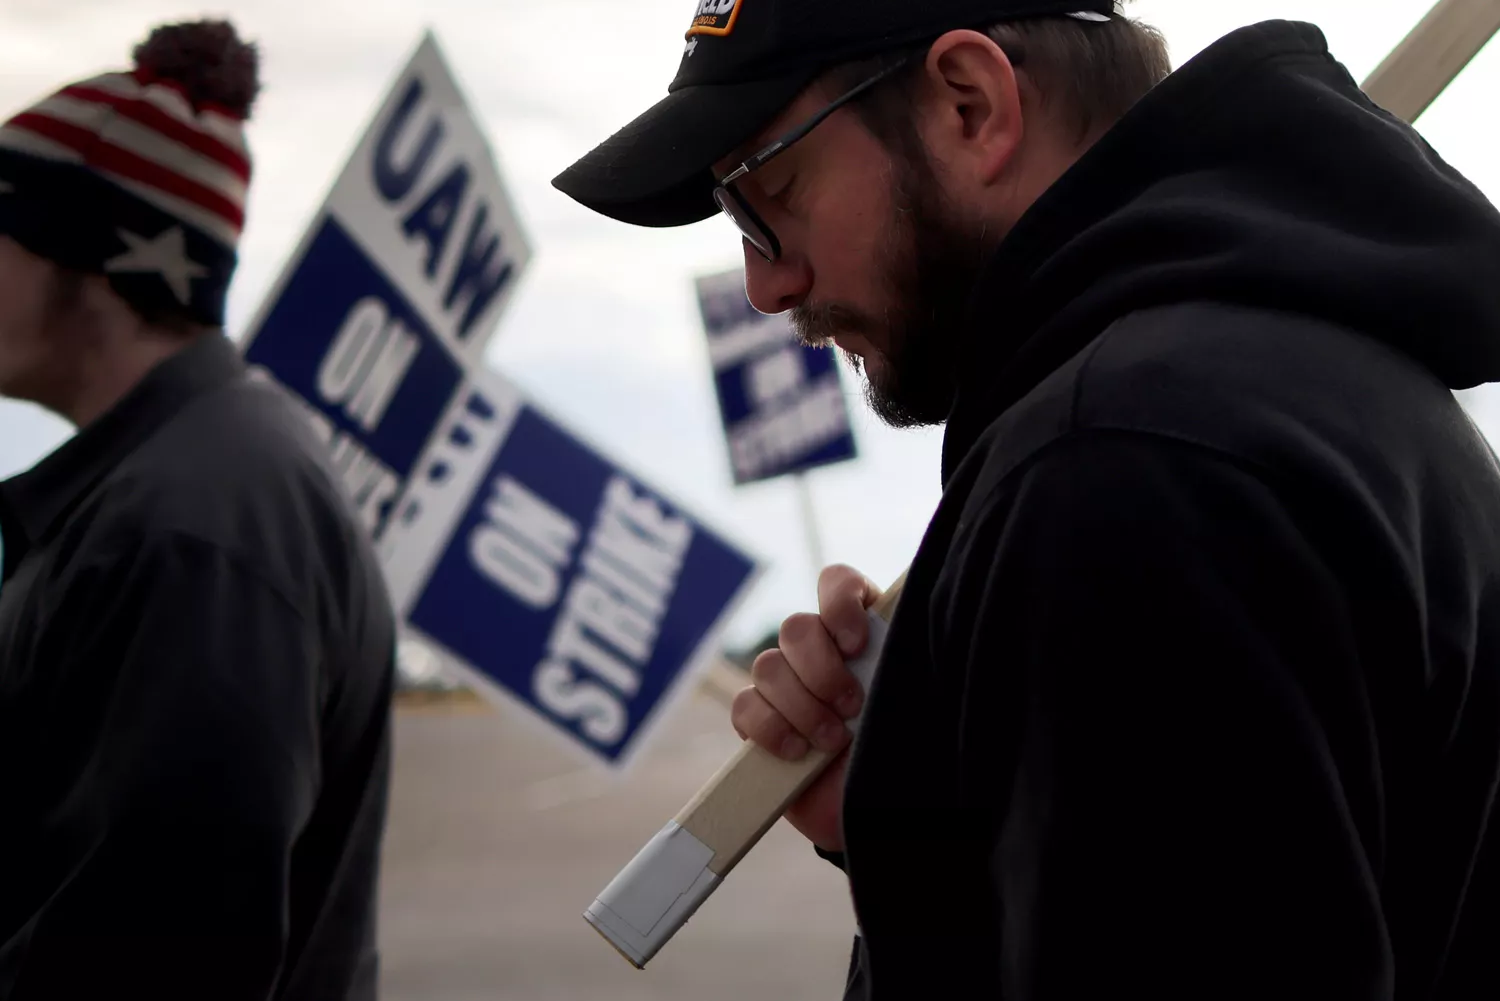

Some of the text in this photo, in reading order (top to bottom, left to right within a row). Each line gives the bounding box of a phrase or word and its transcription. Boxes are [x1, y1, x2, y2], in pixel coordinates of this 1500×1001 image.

[371, 76, 513, 338] UAW
[316, 296, 422, 436] ON
[469, 475, 581, 609] ON
[532, 477, 694, 745] STRIKE
